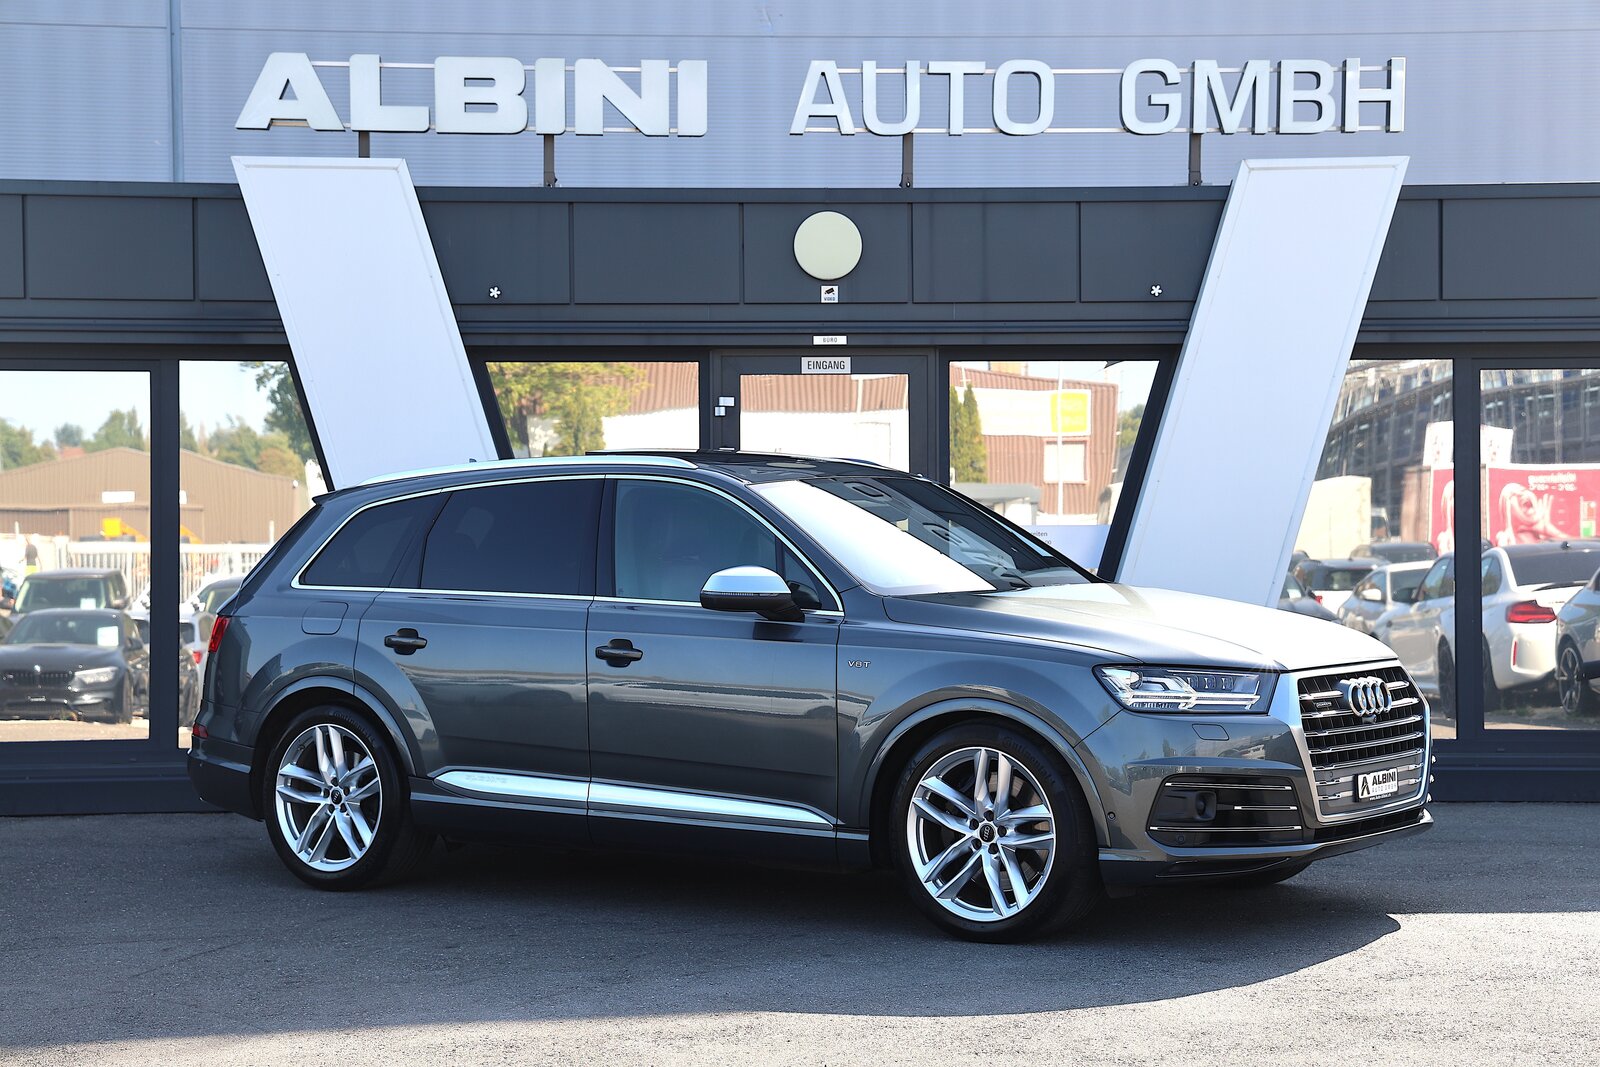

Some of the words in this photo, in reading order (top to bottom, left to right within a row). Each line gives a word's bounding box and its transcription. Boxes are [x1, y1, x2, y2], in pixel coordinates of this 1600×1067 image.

[235, 52, 708, 136] ALBINI
[789, 59, 1055, 136] AUTO
[1121, 56, 1406, 135] GMBH
[807, 360, 846, 370] EINGANG
[848, 660, 871, 668] V8T
[1372, 771, 1396, 786] ALBINI
